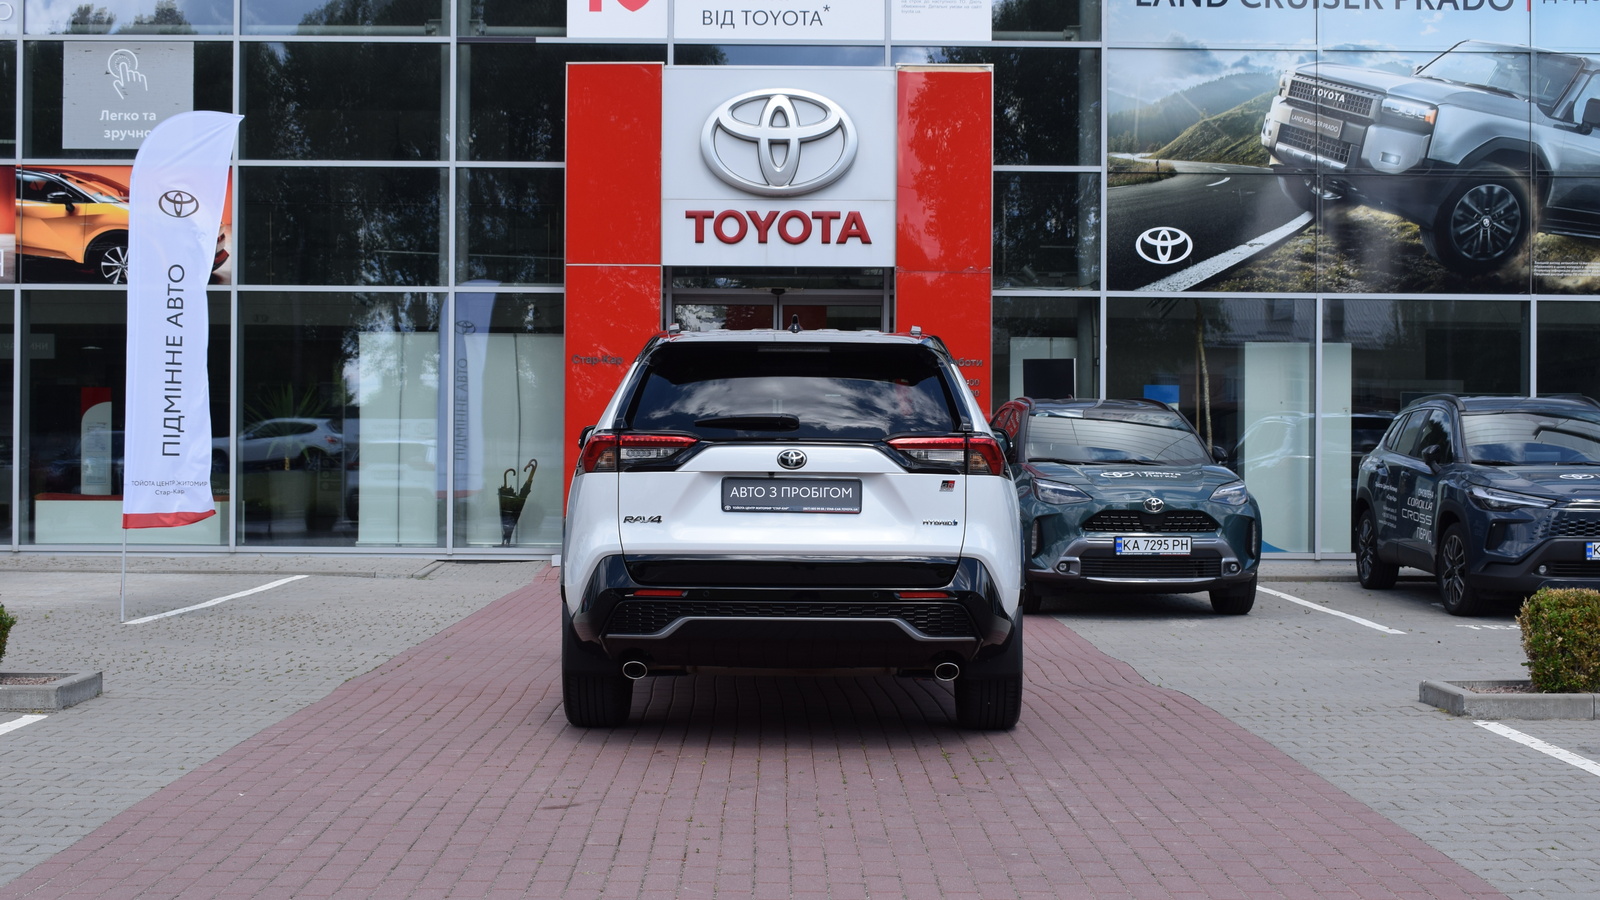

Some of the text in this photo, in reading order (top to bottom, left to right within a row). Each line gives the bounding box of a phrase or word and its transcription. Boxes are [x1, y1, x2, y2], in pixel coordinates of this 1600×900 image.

[702, 10, 736, 29] ВІД
[1312, 88, 1345, 102] TOYOTA
[100, 110, 157, 121] Легко та
[685, 209, 872, 245] TOYOTA
[162, 263, 186, 458] ПІДМІННЕ АВТО
[572, 354, 624, 366] Стар-Кар
[156, 480, 175, 488] ЦЕНТР
[729, 486, 853, 499] АВТО З ПРОБІГОМ
[1407, 496, 1433, 511] COROLLA
[623, 515, 663, 524] RAV4
[1401, 508, 1433, 526] CROSS
[1123, 539, 1189, 551] KA 7295 PH
